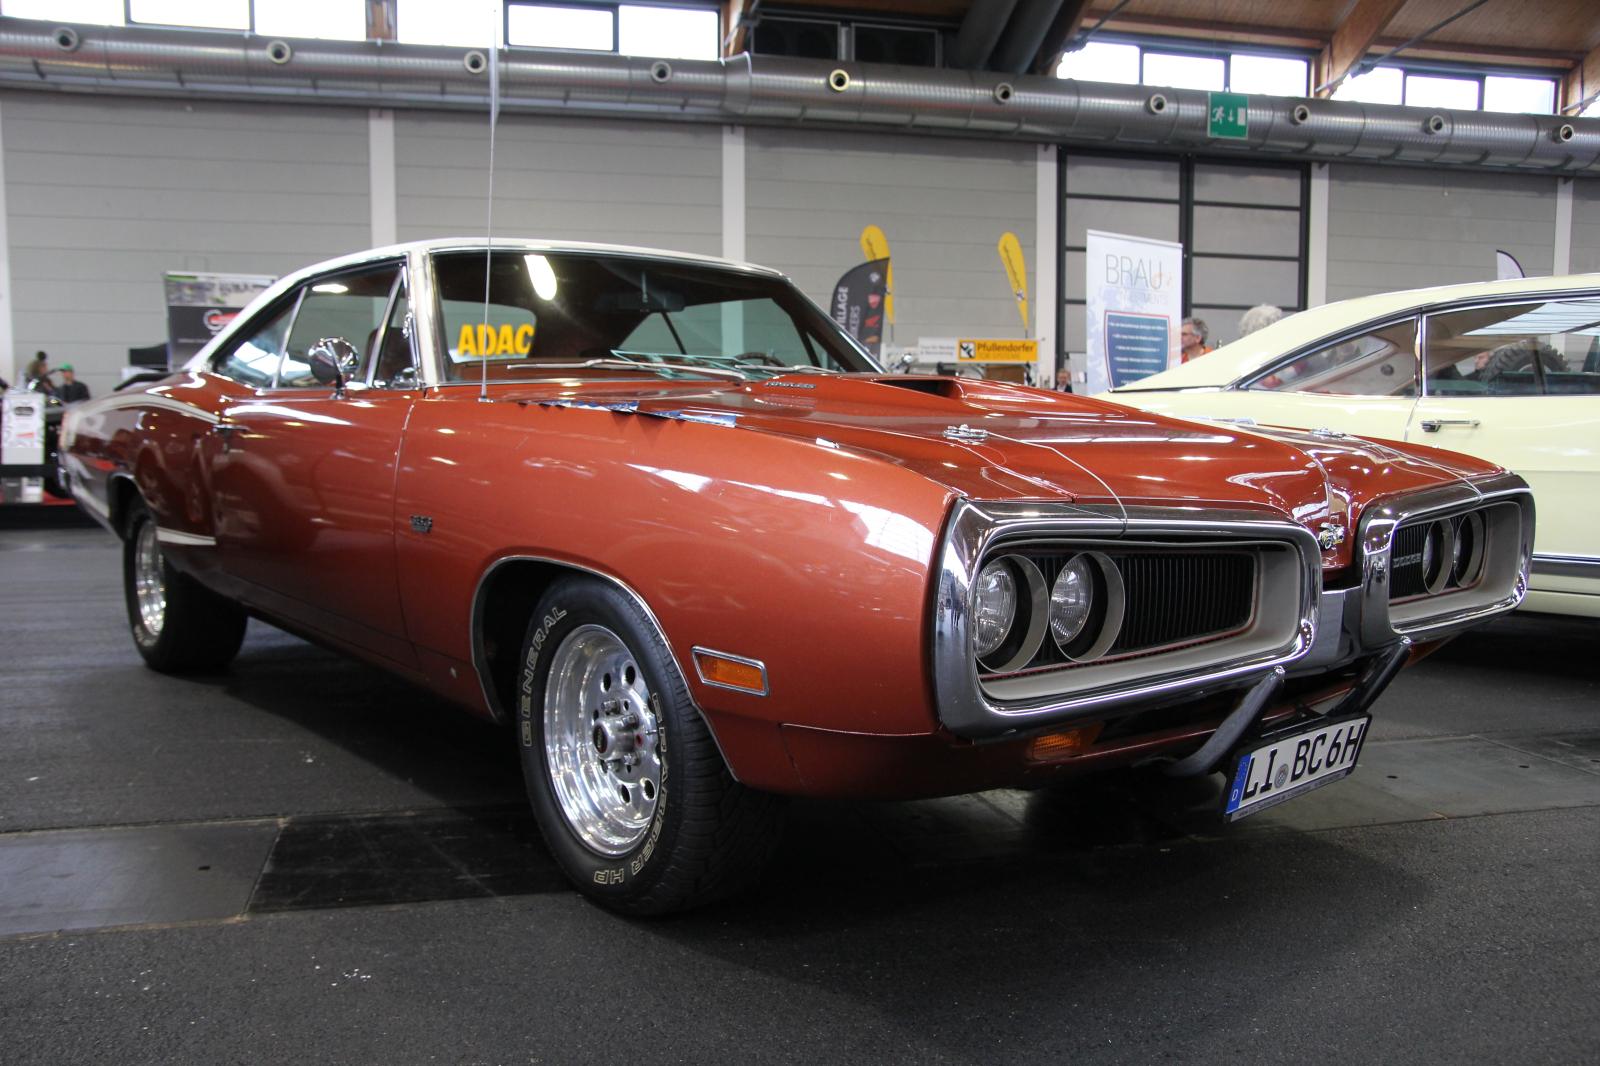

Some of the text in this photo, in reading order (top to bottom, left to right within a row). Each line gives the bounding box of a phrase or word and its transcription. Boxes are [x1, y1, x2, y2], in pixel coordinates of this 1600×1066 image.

[1106, 253, 1162, 290] BRAU
[457, 323, 535, 356] ADAC
[976, 342, 1034, 352] Pfullendorfer
[521, 606, 568, 747] GENERAL
[1241, 748, 1278, 801] LI
[593, 868, 625, 885] HP
